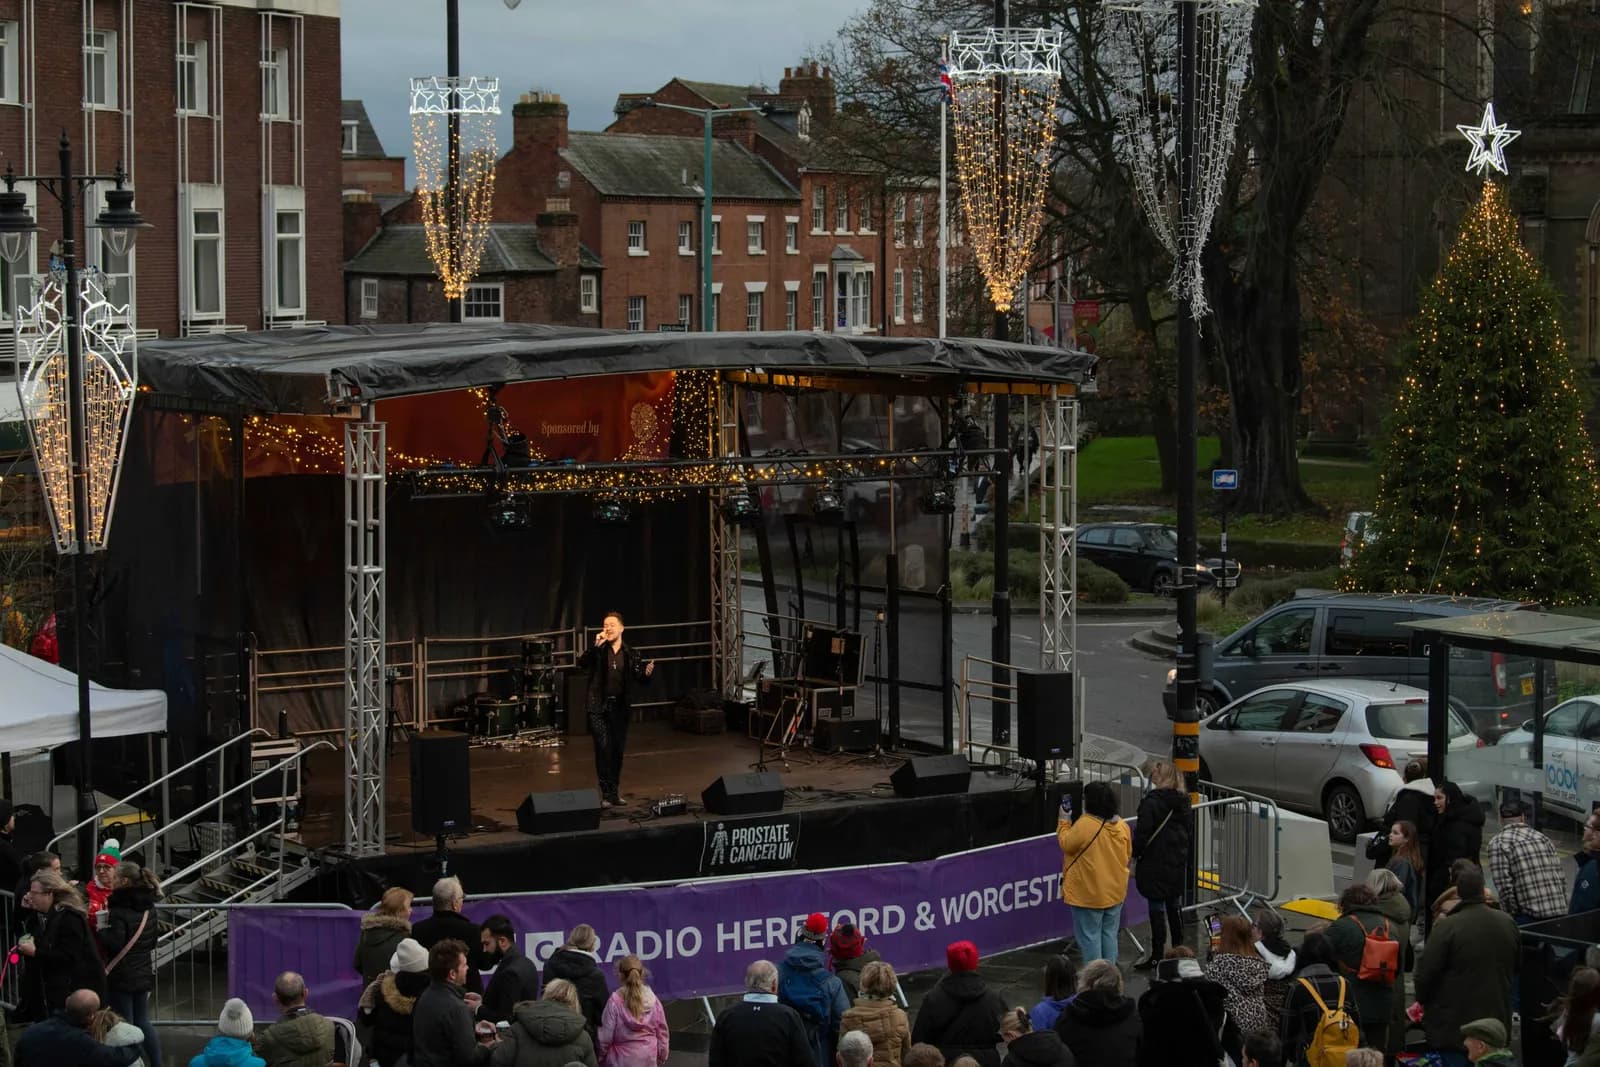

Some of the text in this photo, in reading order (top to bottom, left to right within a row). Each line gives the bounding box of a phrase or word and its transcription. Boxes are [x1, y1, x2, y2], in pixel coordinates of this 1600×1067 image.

[541, 420, 600, 435] Sponsored by
[732, 824, 790, 845] PROSTATE
[729, 842, 793, 863] CANCER UK
[915, 900, 936, 931] &
